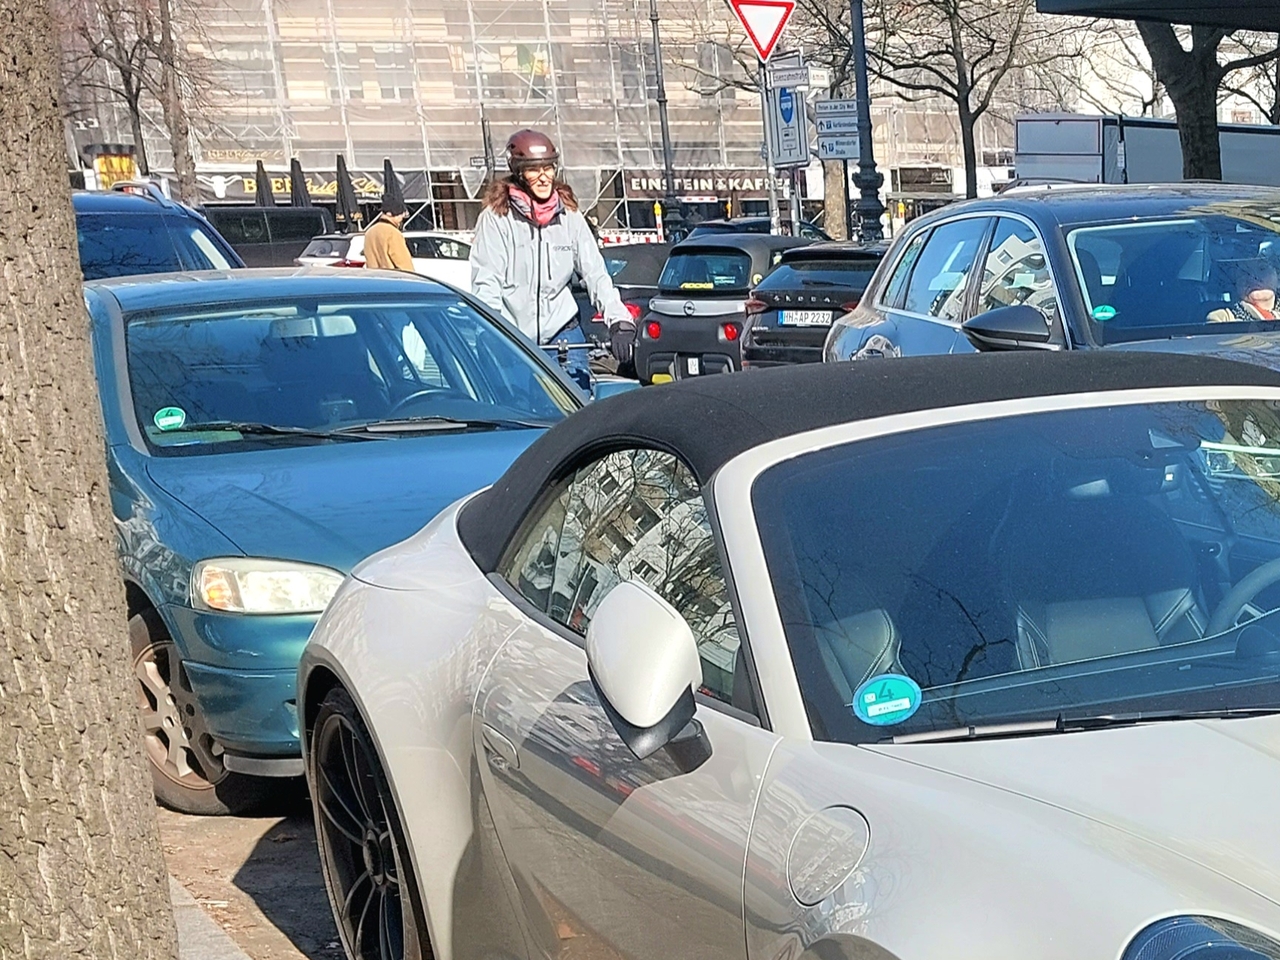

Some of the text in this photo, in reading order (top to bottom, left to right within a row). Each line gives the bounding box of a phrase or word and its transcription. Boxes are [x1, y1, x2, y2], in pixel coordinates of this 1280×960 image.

[631, 178, 713, 191] EINSTEIN
[784, 312, 831, 324] HH AP 2232
[878, 681, 894, 699] 4
